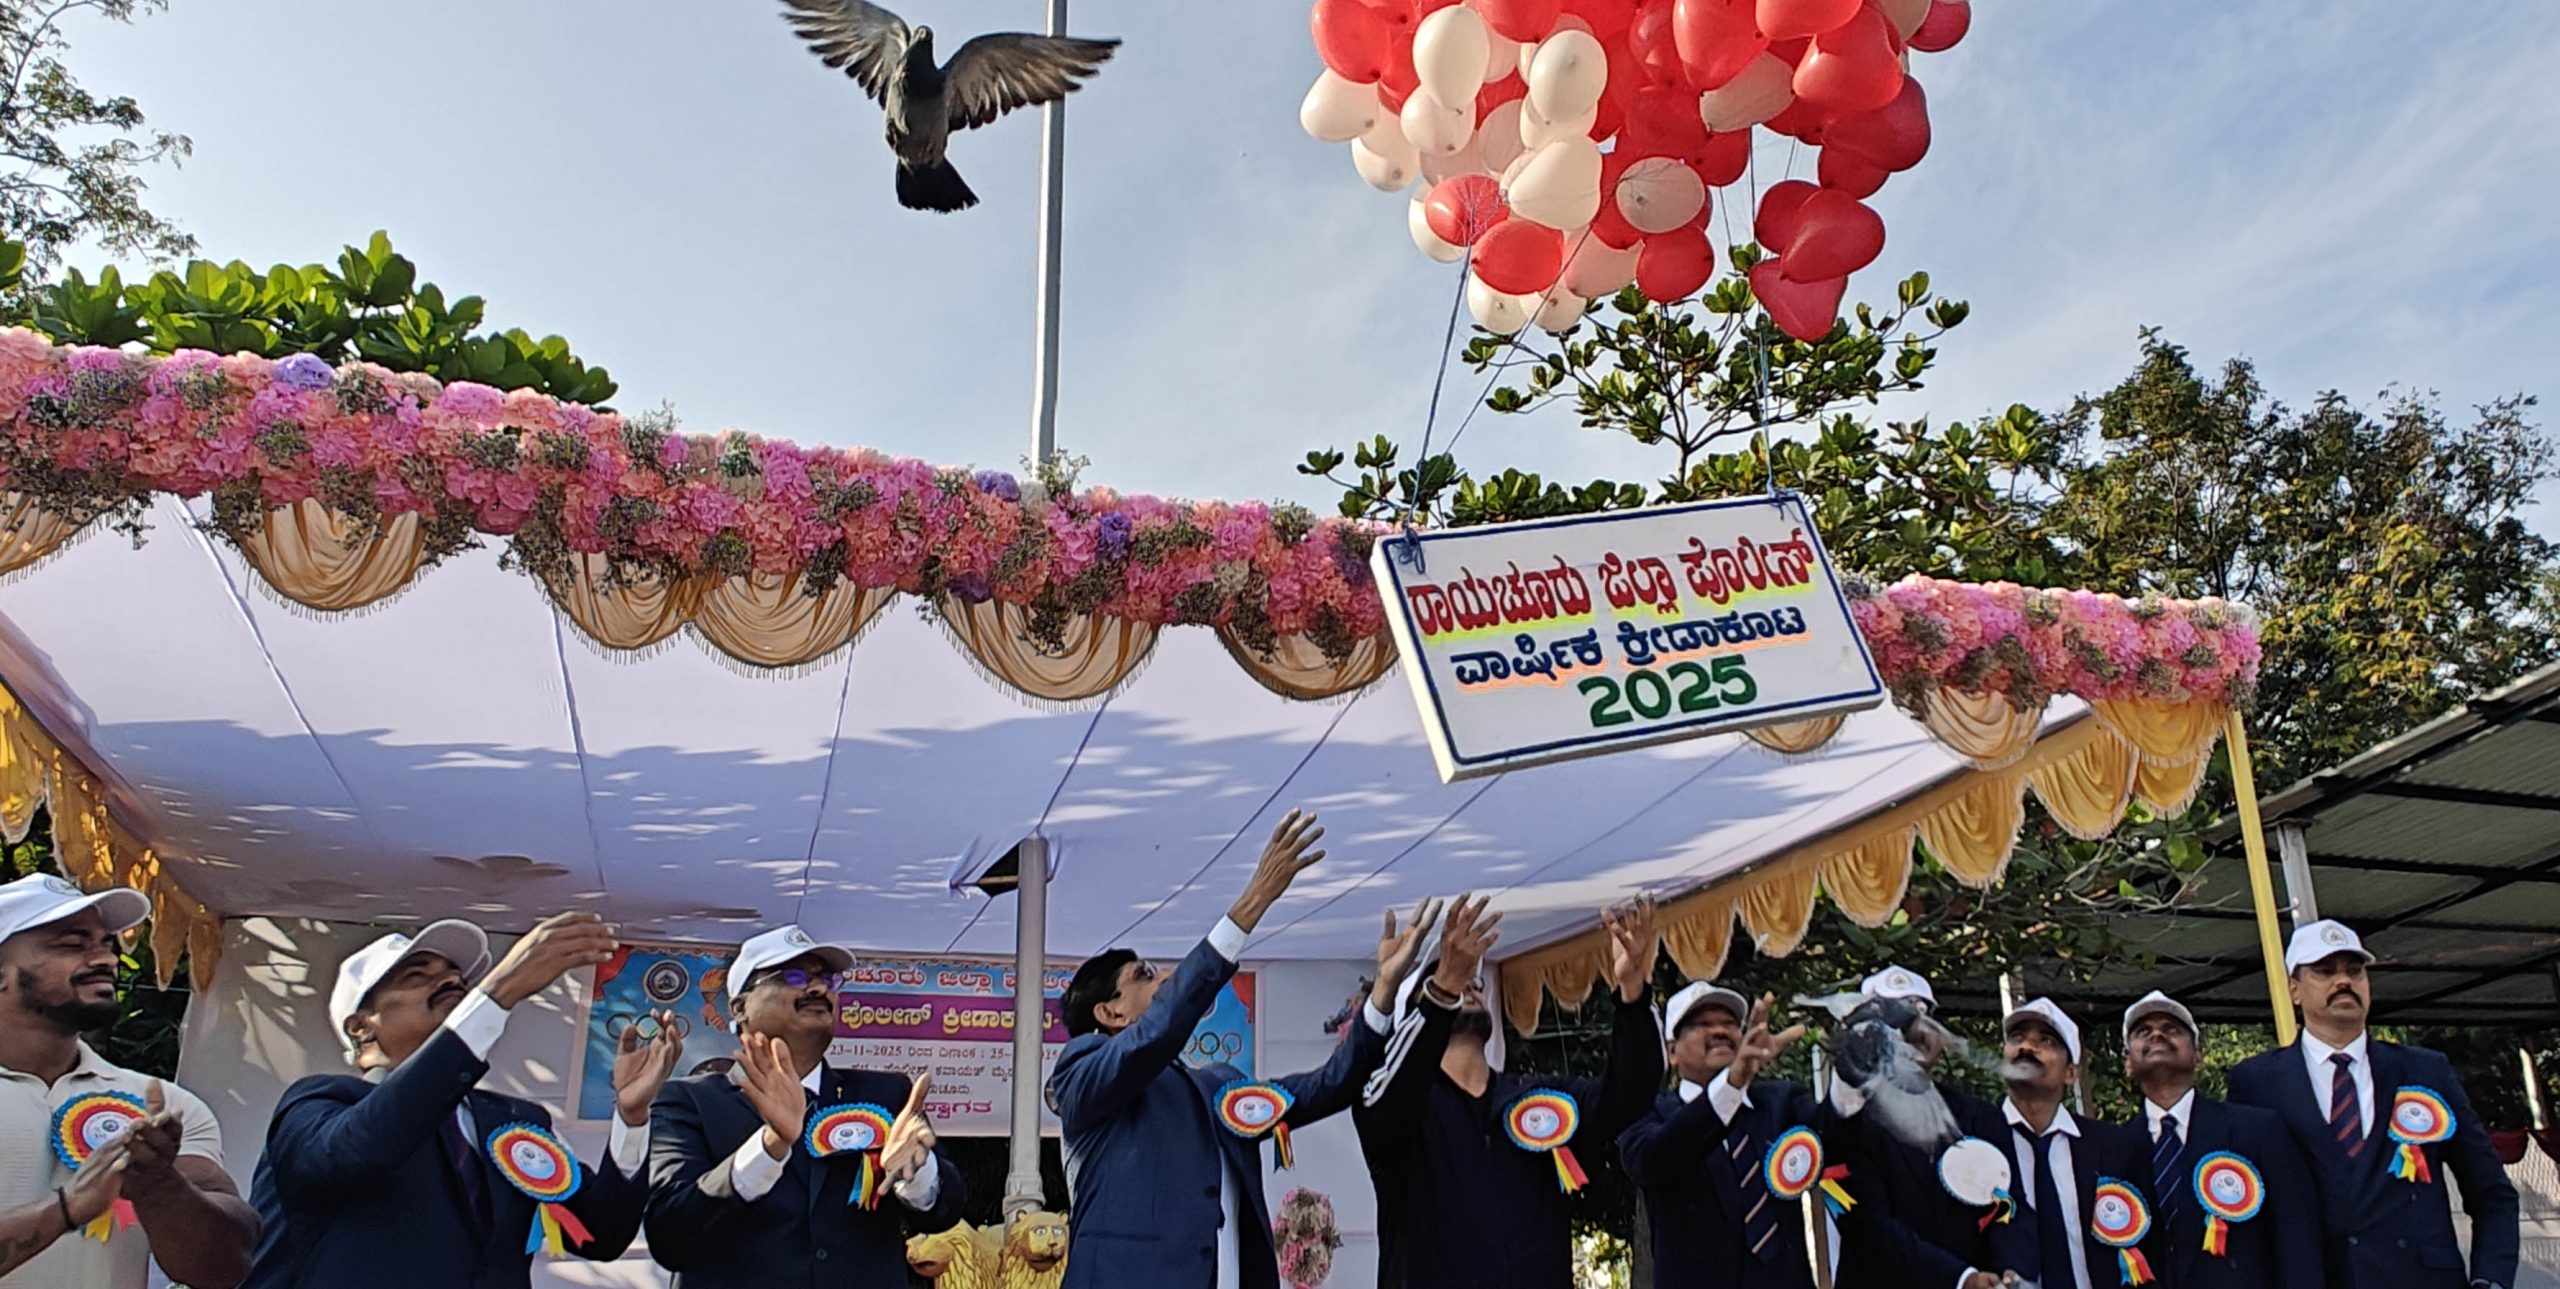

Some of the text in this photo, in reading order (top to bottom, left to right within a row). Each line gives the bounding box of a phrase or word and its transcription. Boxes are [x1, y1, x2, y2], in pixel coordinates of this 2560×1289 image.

[1407, 528, 1815, 636] ರಾಯಚೂರು ಜಿಲ್ಲಾ ಪೊಲೀಸ್
[1450, 606, 1806, 685] ವಾರ್ಷಿಕ ಕ್ರೀಡಾಕೂಟ
[1578, 654, 1758, 728] 2025
[829, 1043, 903, 1057] 23-11-2025
[840, 1000, 932, 1030] ಪೊಲೀಸ್
